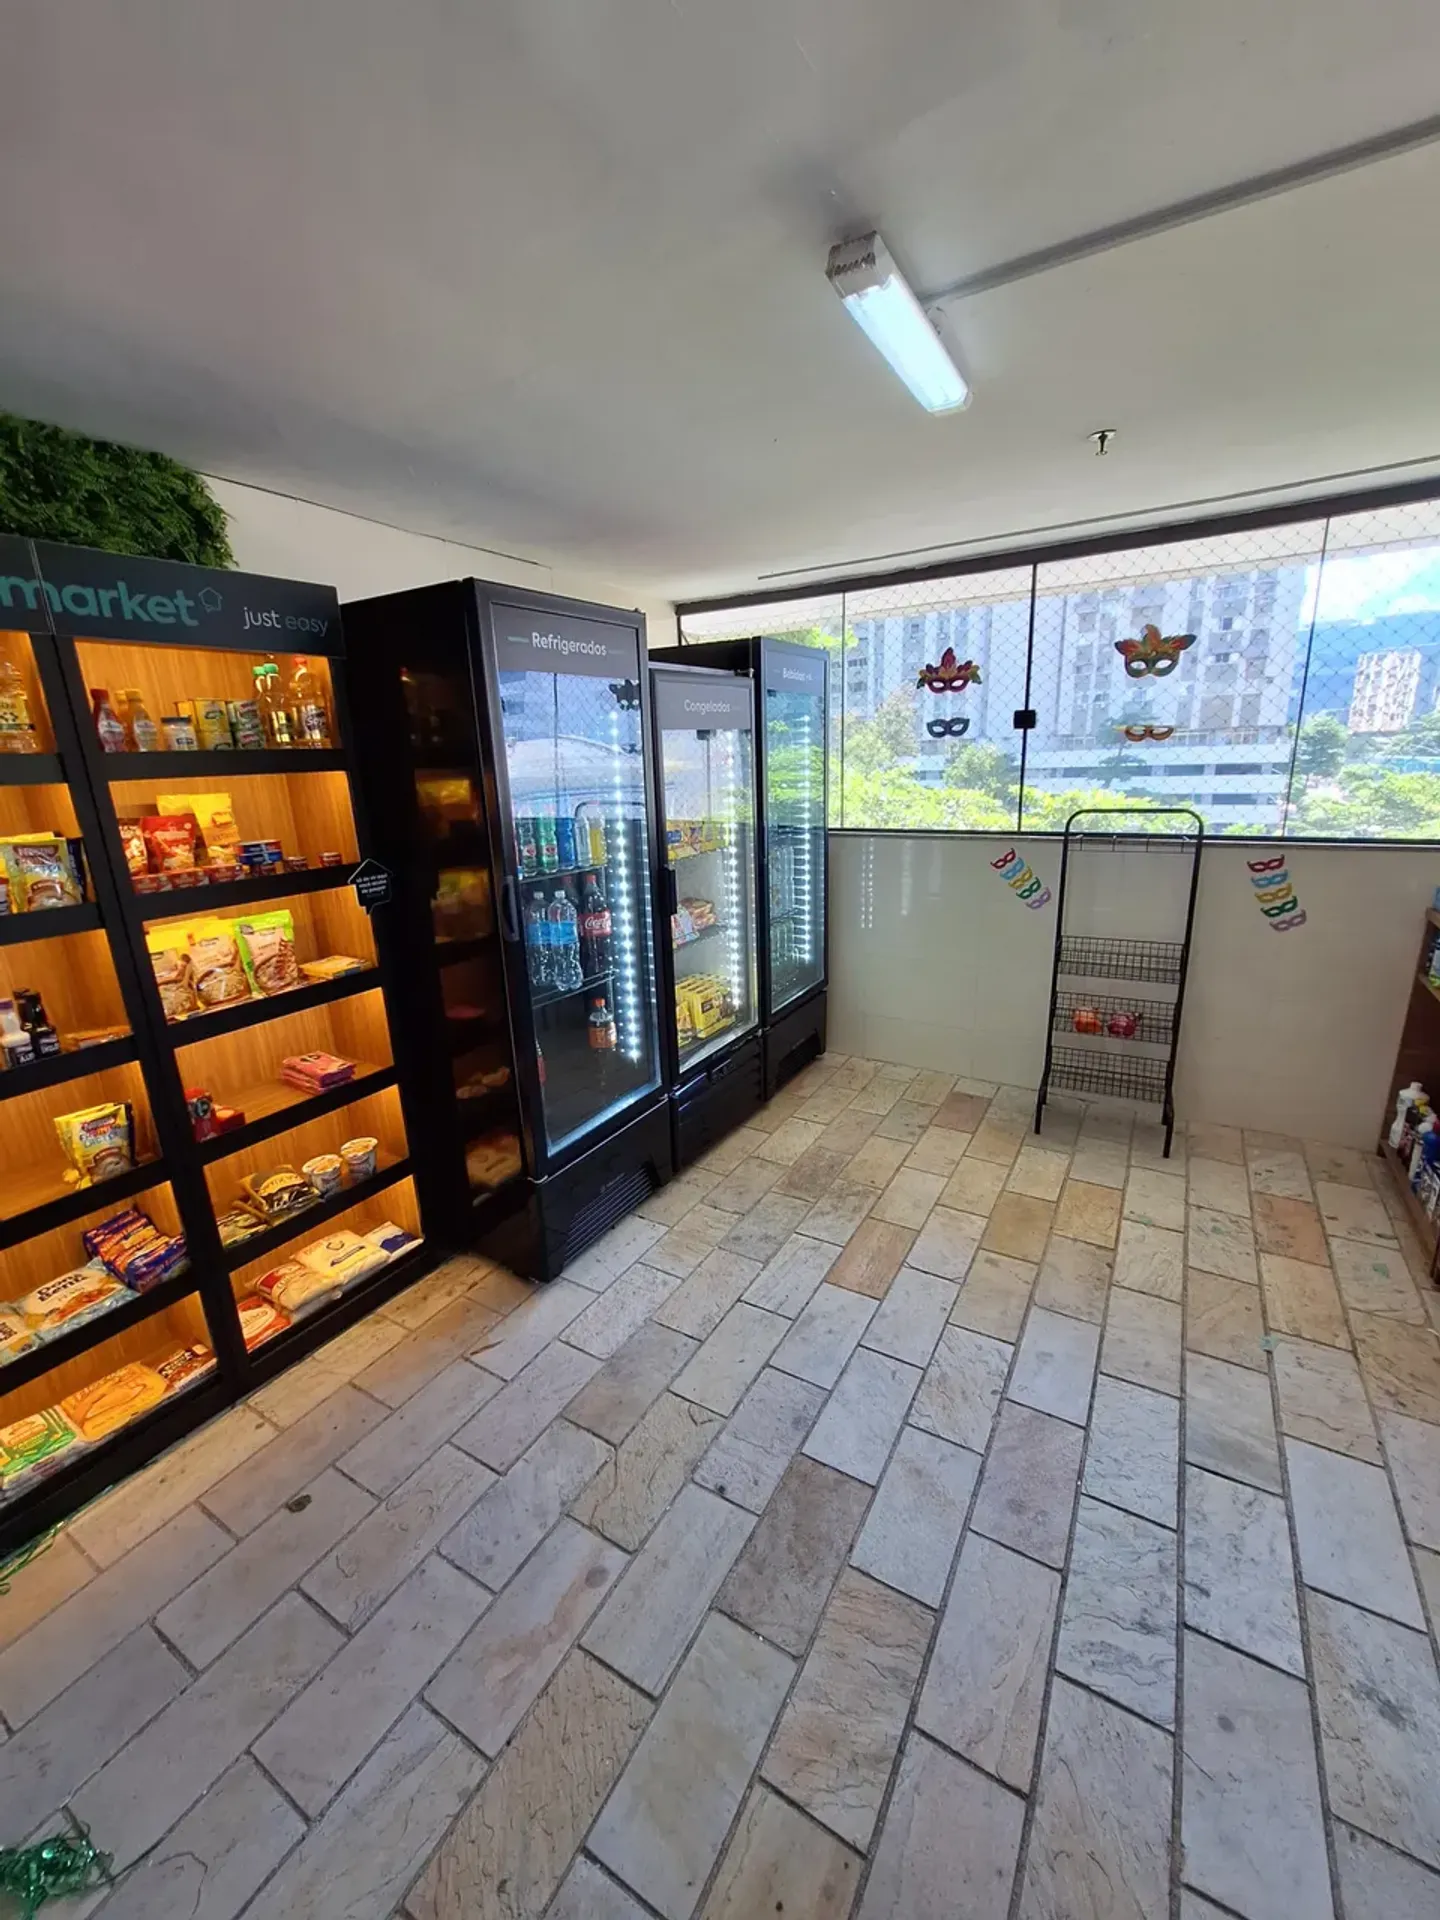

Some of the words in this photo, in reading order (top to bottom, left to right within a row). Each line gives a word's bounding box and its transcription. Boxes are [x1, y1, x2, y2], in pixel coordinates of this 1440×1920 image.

[0, 575, 200, 627] market
[243, 605, 282, 630] just
[285, 616, 329, 637] easy
[531, 631, 608, 657] Refrigerados
[684, 698, 731, 714] Congelados
